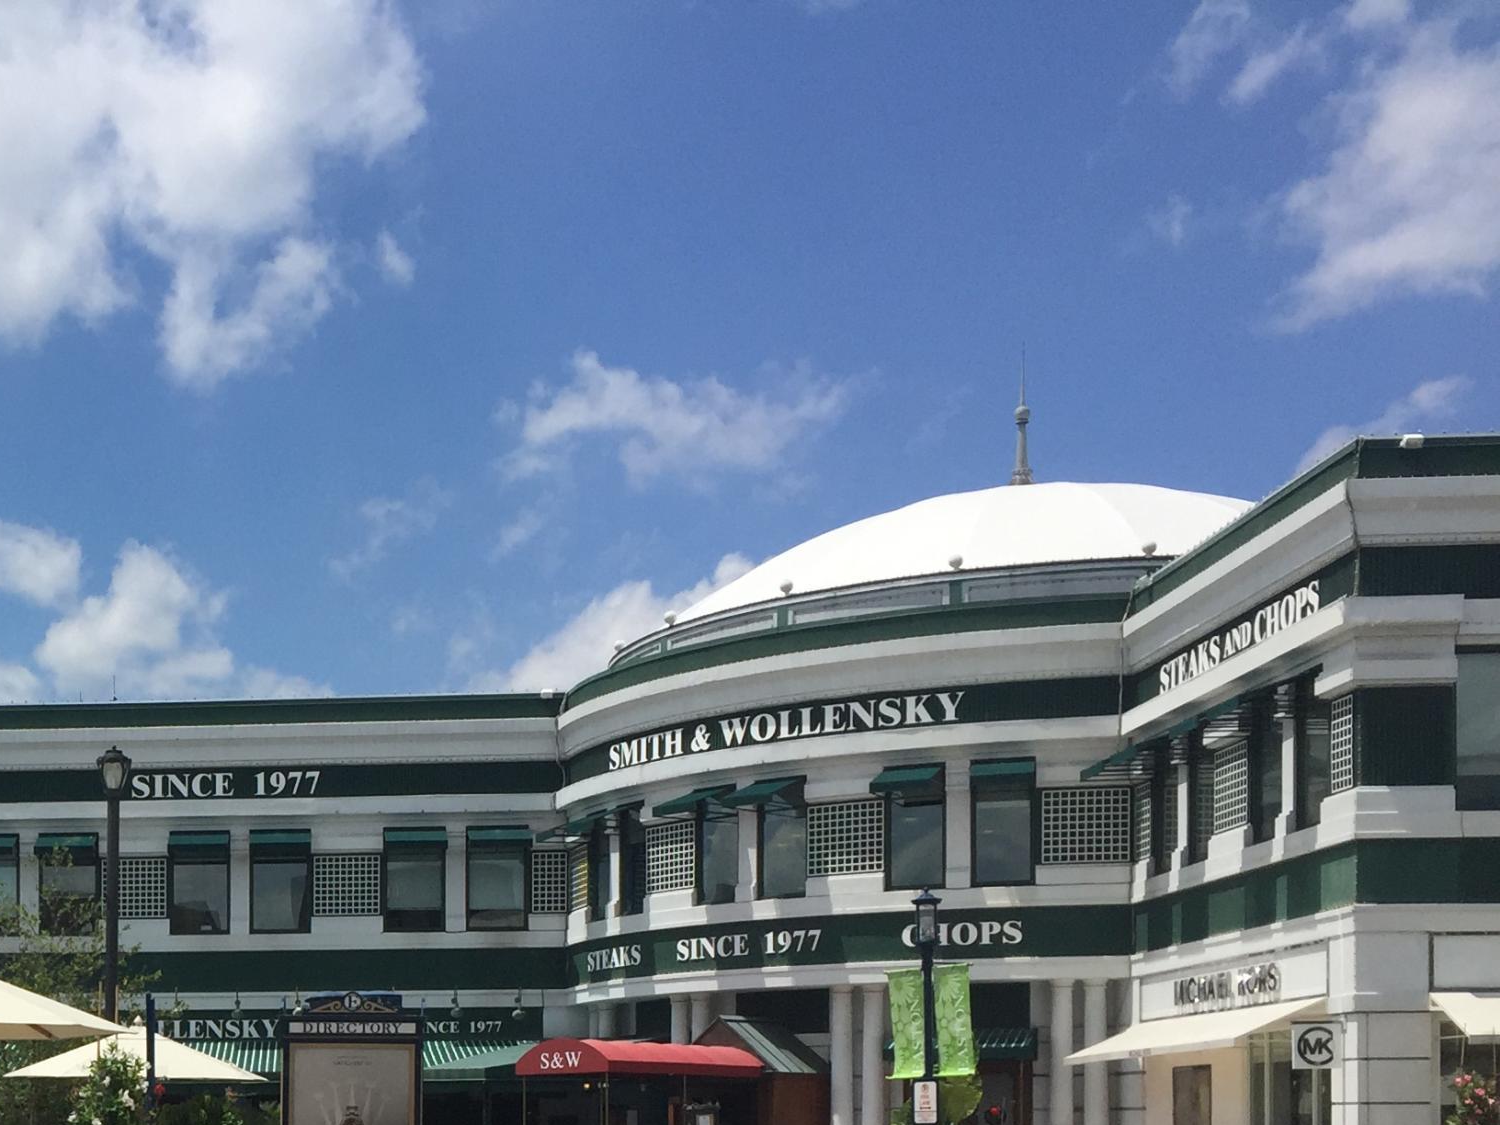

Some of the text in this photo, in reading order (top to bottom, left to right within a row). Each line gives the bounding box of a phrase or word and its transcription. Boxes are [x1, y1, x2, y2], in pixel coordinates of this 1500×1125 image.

[1159, 579, 1320, 696] STEAKS AND CHOPS
[608, 690, 966, 771] SMITH & WOLLENSKY
[131, 770, 321, 799] SINCE 1977
[587, 944, 641, 973] STEAKS
[676, 929, 822, 962] SINCE 1977
[157, 1019, 280, 1039] LLENSKY
[303, 1022, 400, 1034] DIRECTORY
[426, 1020, 502, 1034] NCE 1977
[540, 1051, 582, 1070] S&W
